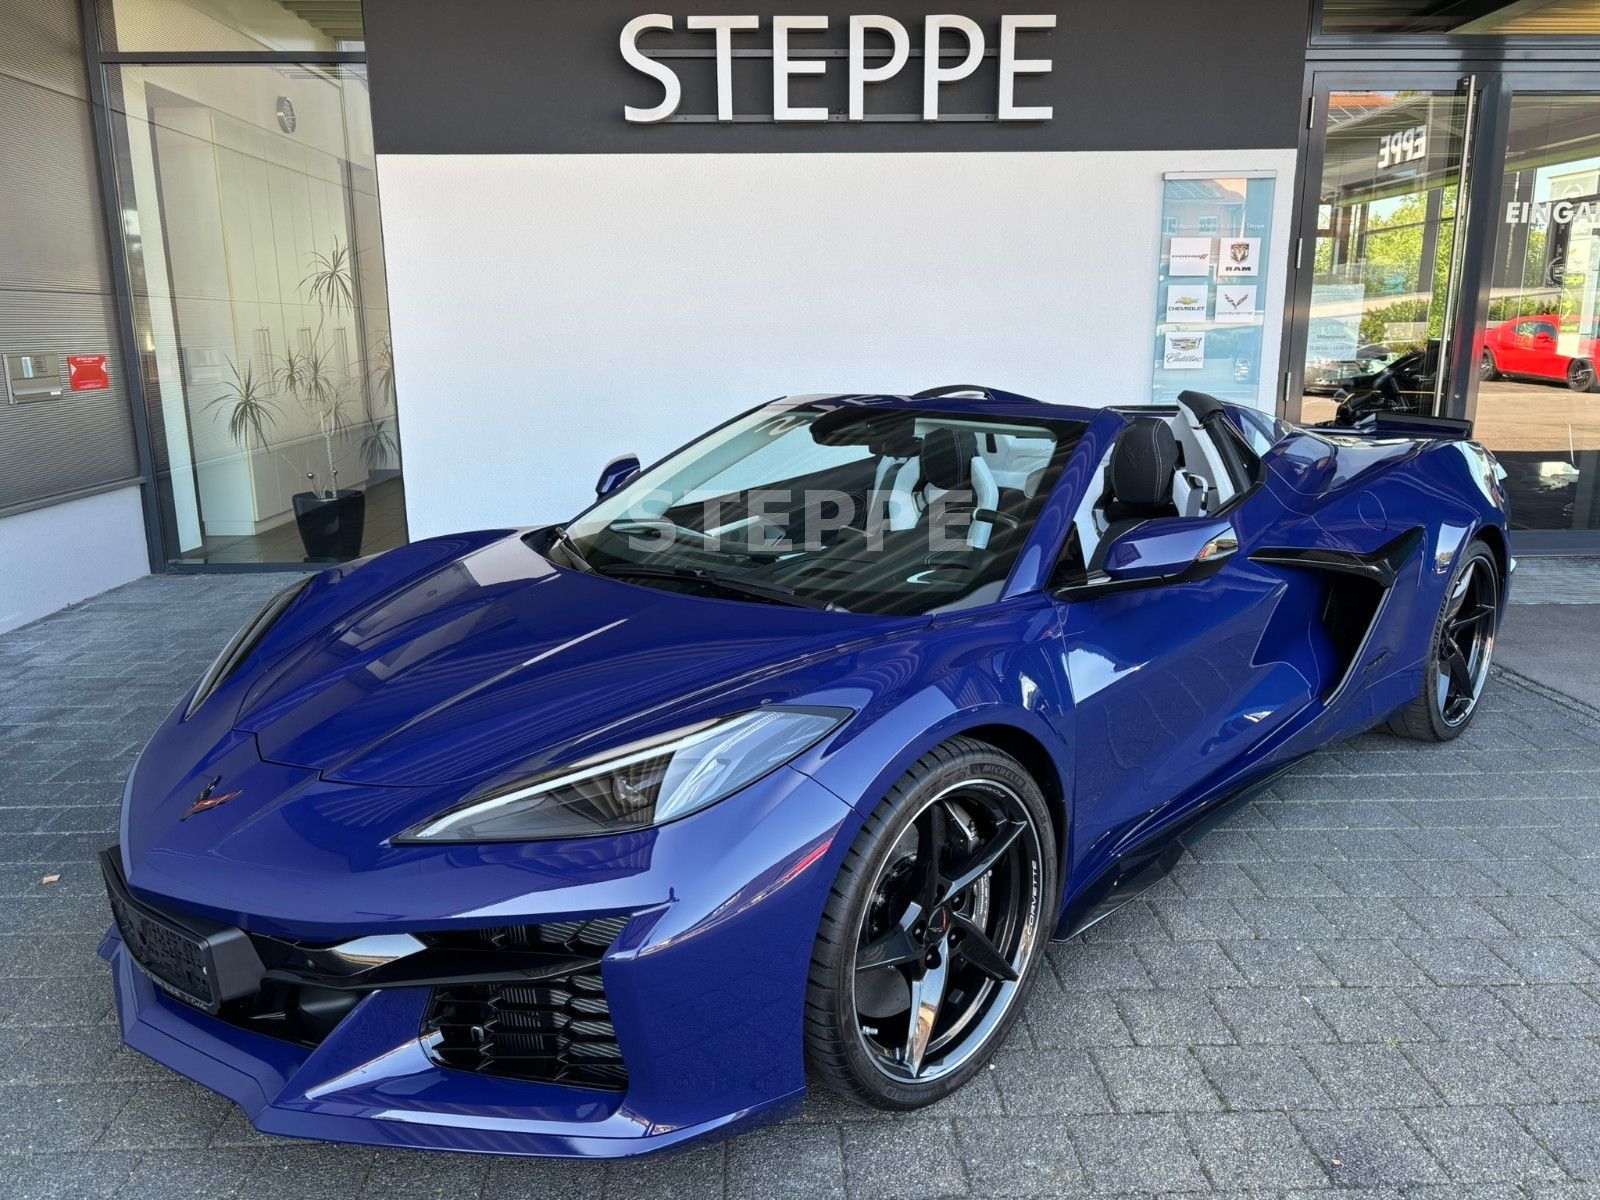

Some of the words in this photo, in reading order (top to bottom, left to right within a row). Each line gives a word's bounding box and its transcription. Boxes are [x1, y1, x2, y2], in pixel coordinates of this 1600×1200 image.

[619, 14, 1057, 123] STEPPE
[1505, 201, 1600, 224] EINGA
[1166, 353, 1202, 363] Cadillac
[1027, 860, 1037, 935] CORVETTE
